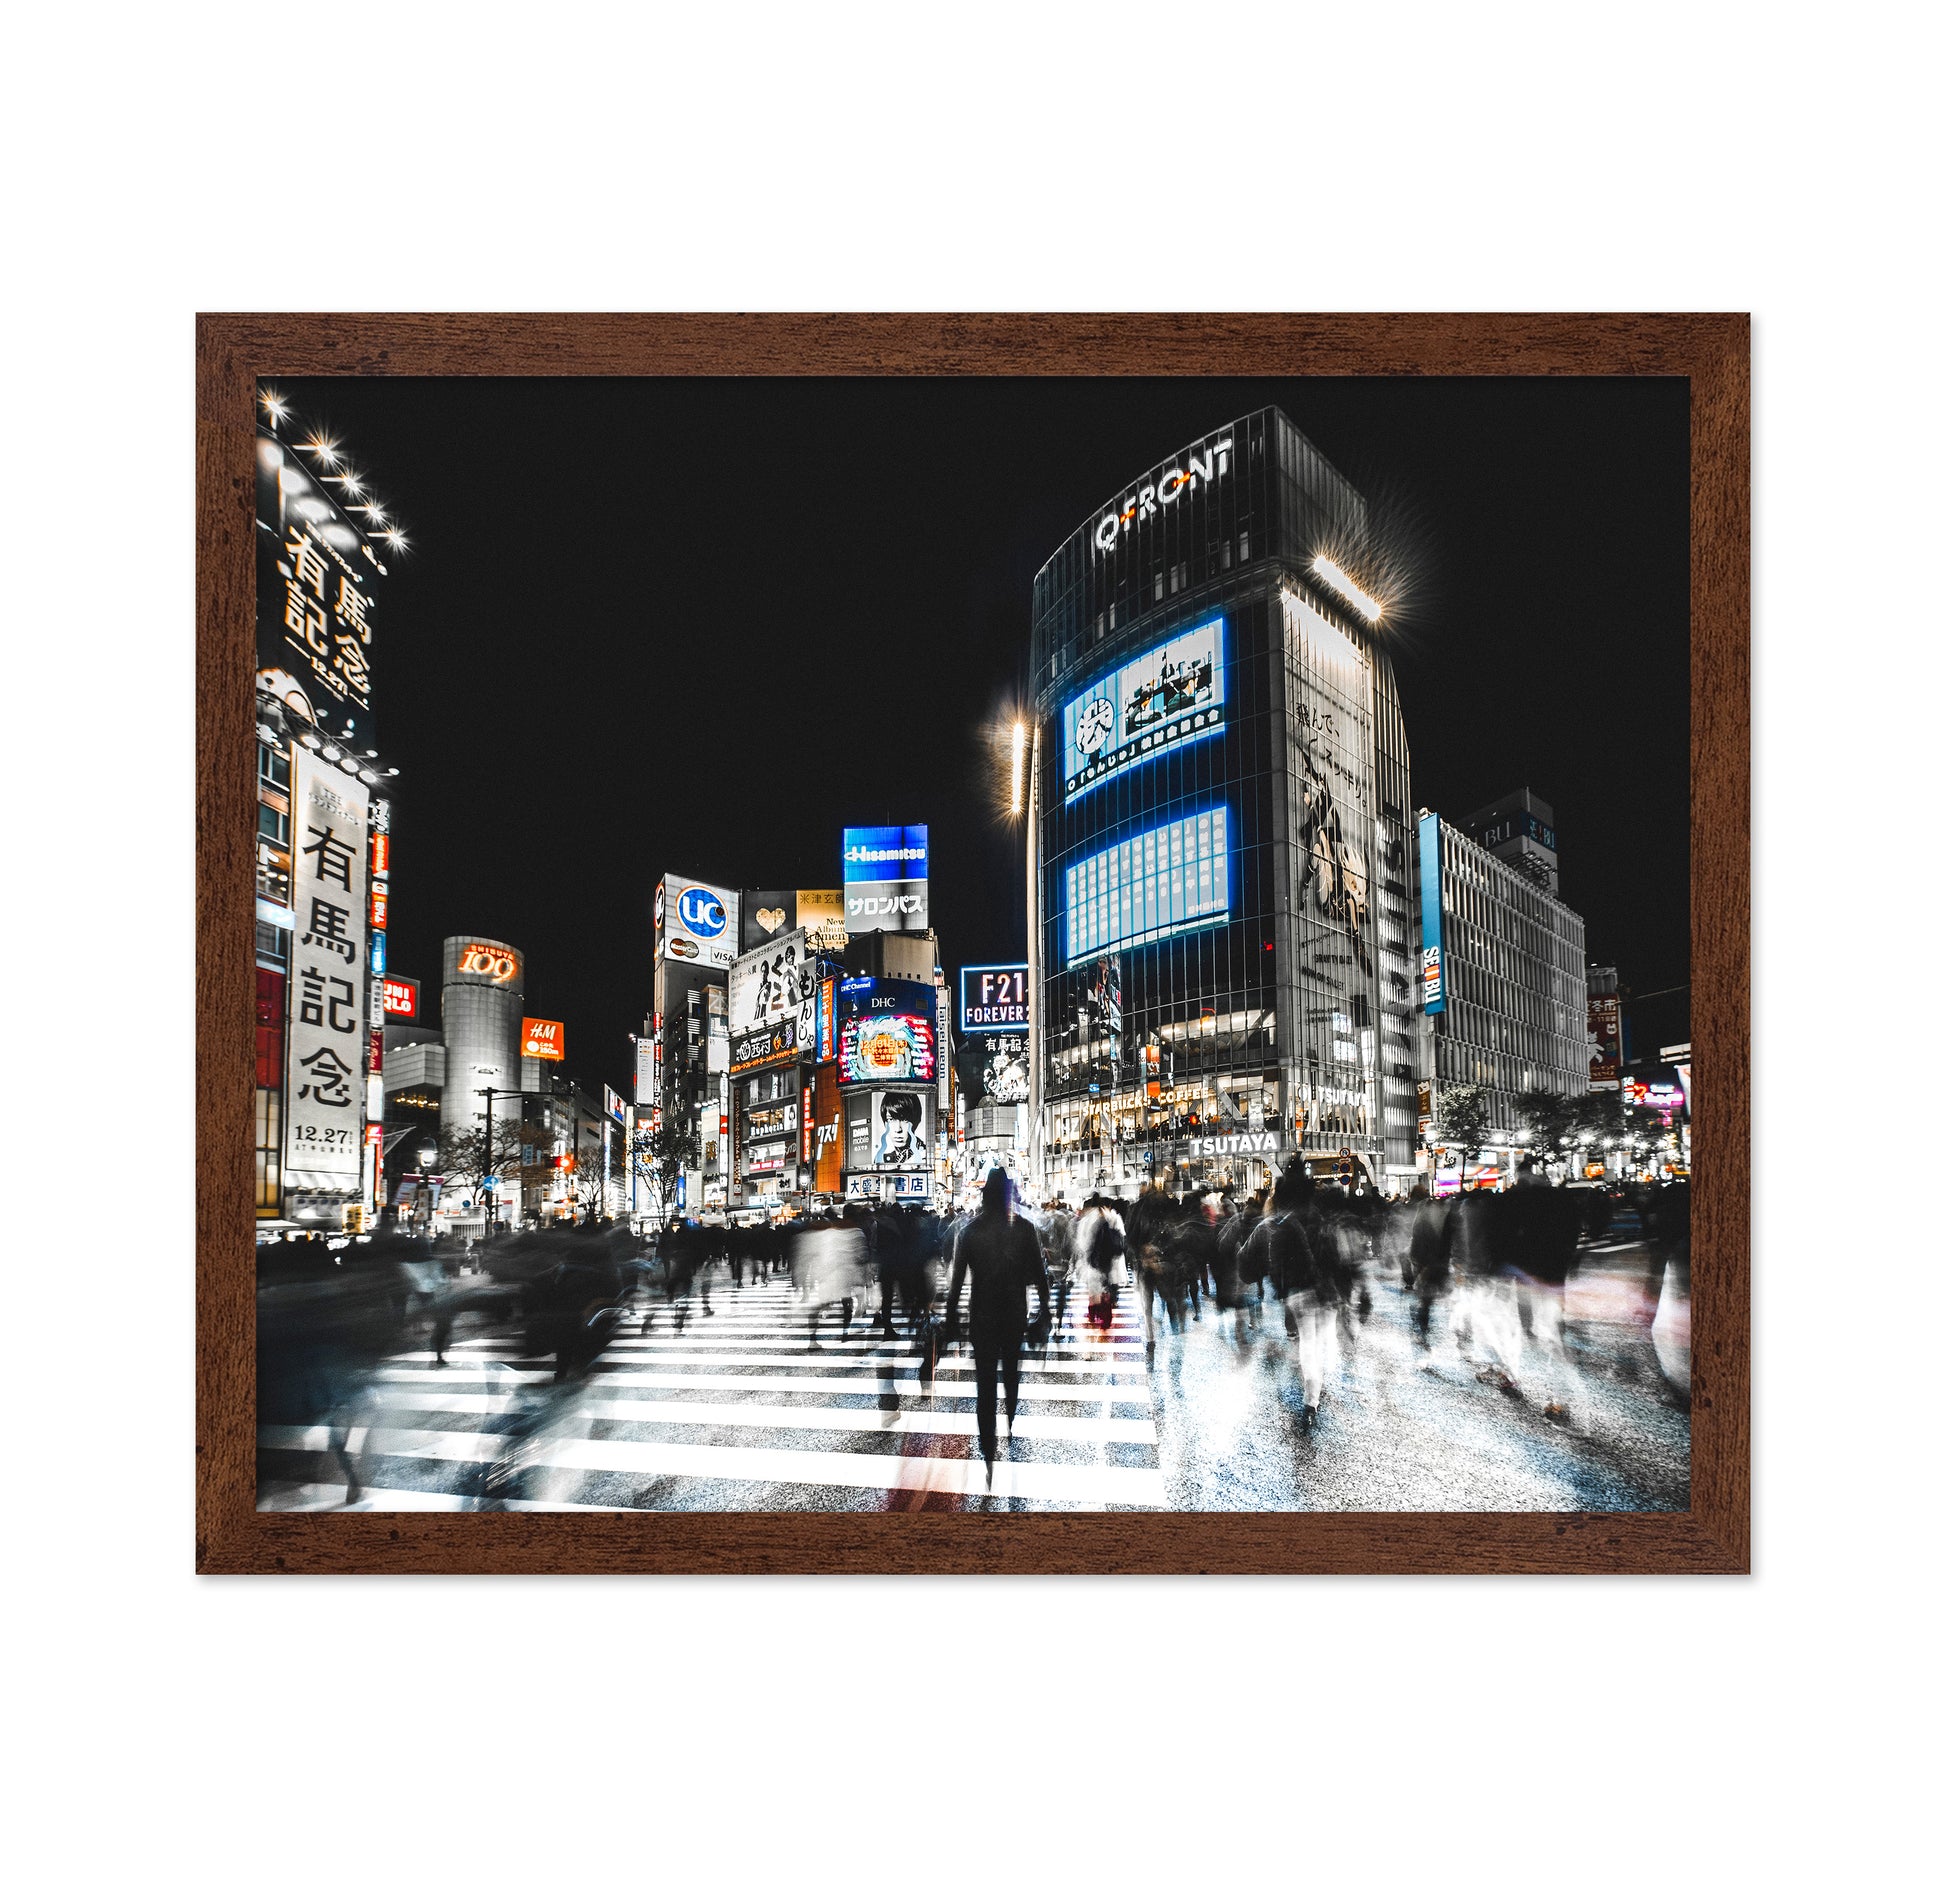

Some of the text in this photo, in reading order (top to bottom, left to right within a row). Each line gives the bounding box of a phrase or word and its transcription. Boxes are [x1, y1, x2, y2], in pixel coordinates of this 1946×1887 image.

[1095, 438, 1233, 552] QFRONT
[844, 846, 926, 862] Hisamitsu
[682, 895, 725, 929] UC
[848, 895, 924, 916] サロンパス
[470, 945, 514, 961] SHIBUYA
[714, 952, 734, 962] VISA
[298, 825, 357, 1108] 有馬記念
[458, 951, 515, 983] 109
[1424, 946, 1441, 1004] SEIBU
[982, 972, 1023, 1004] F21
[798, 969, 816, 1047] もんじゃ
[871, 998, 896, 1008] DHC
[966, 1005, 1024, 1023] FOREVER
[530, 1023, 556, 1040] H&M
[751, 1040, 771, 1058] 西村
[1082, 1088, 1210, 1116] STARBUCKS COFFEE
[295, 1125, 348, 1145] 12.27
[816, 1113, 840, 1161] クスリ
[1190, 1134, 1278, 1156] TSUTAYA
